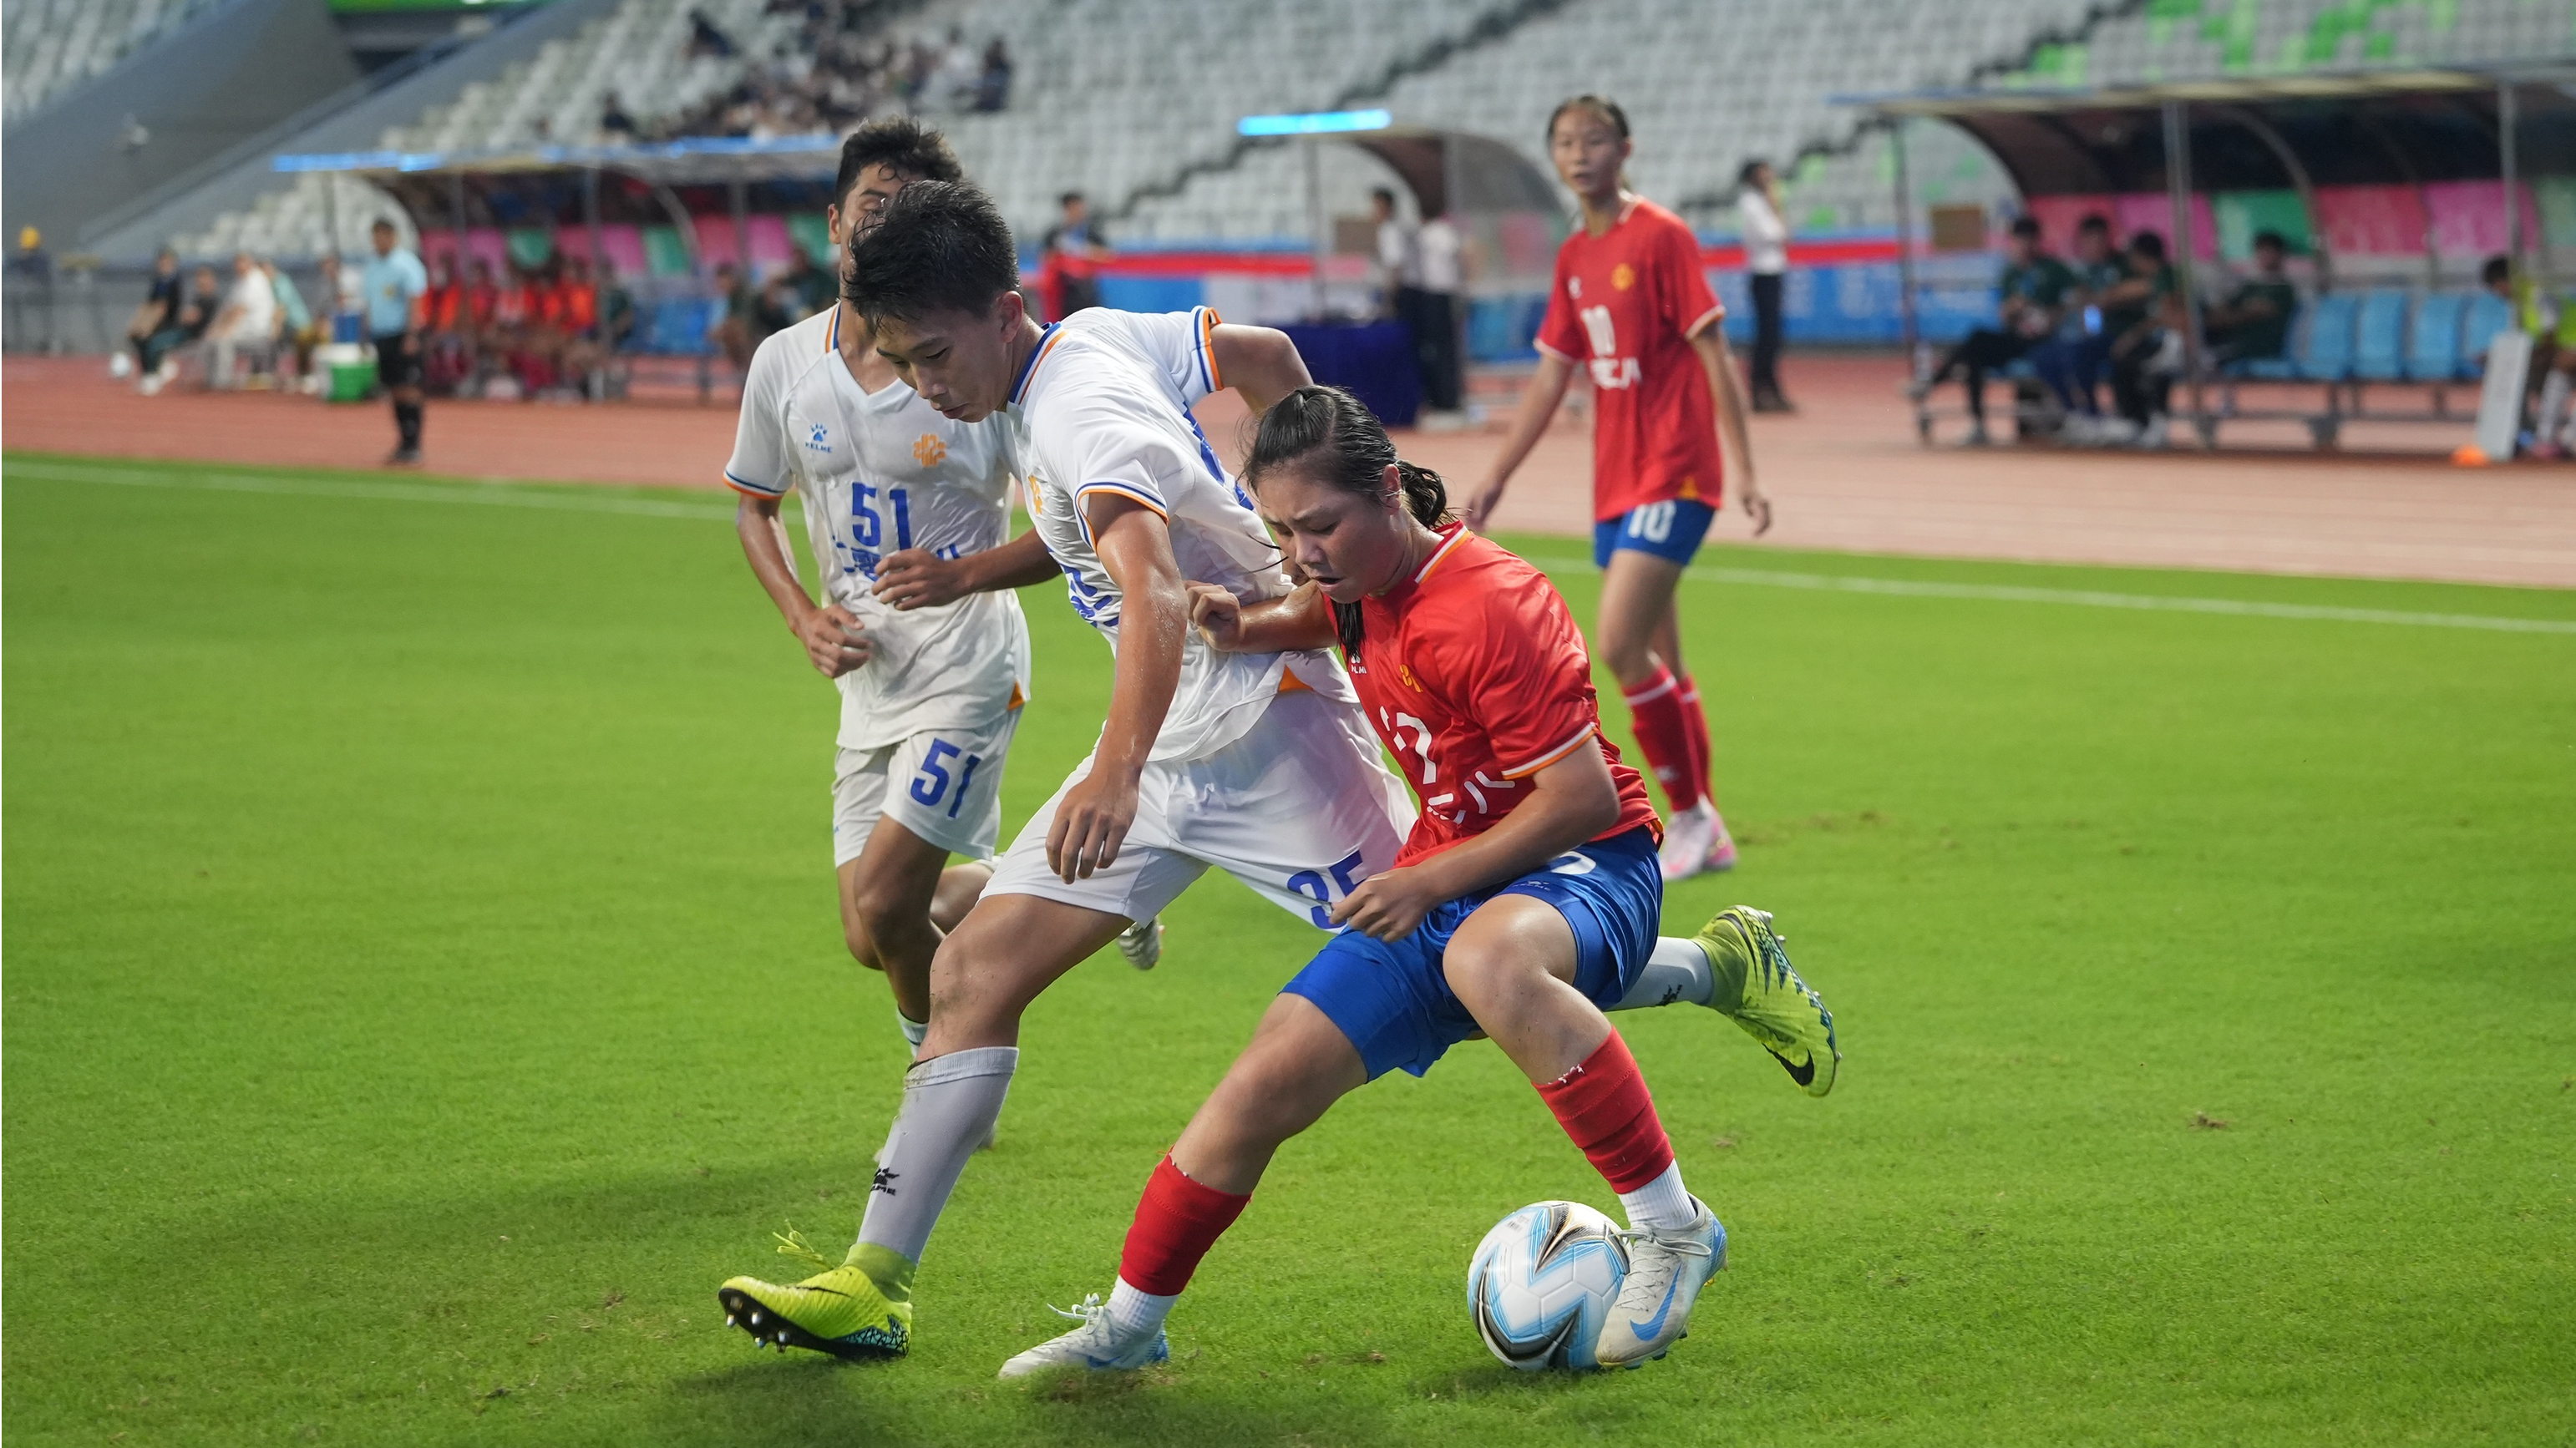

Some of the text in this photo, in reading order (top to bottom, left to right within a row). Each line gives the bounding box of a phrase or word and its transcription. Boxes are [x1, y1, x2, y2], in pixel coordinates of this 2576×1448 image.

[804, 442, 834, 454] KELME
[851, 481, 911, 551] 51
[1628, 500, 1677, 544] 10
[910, 737, 981, 818] 51
